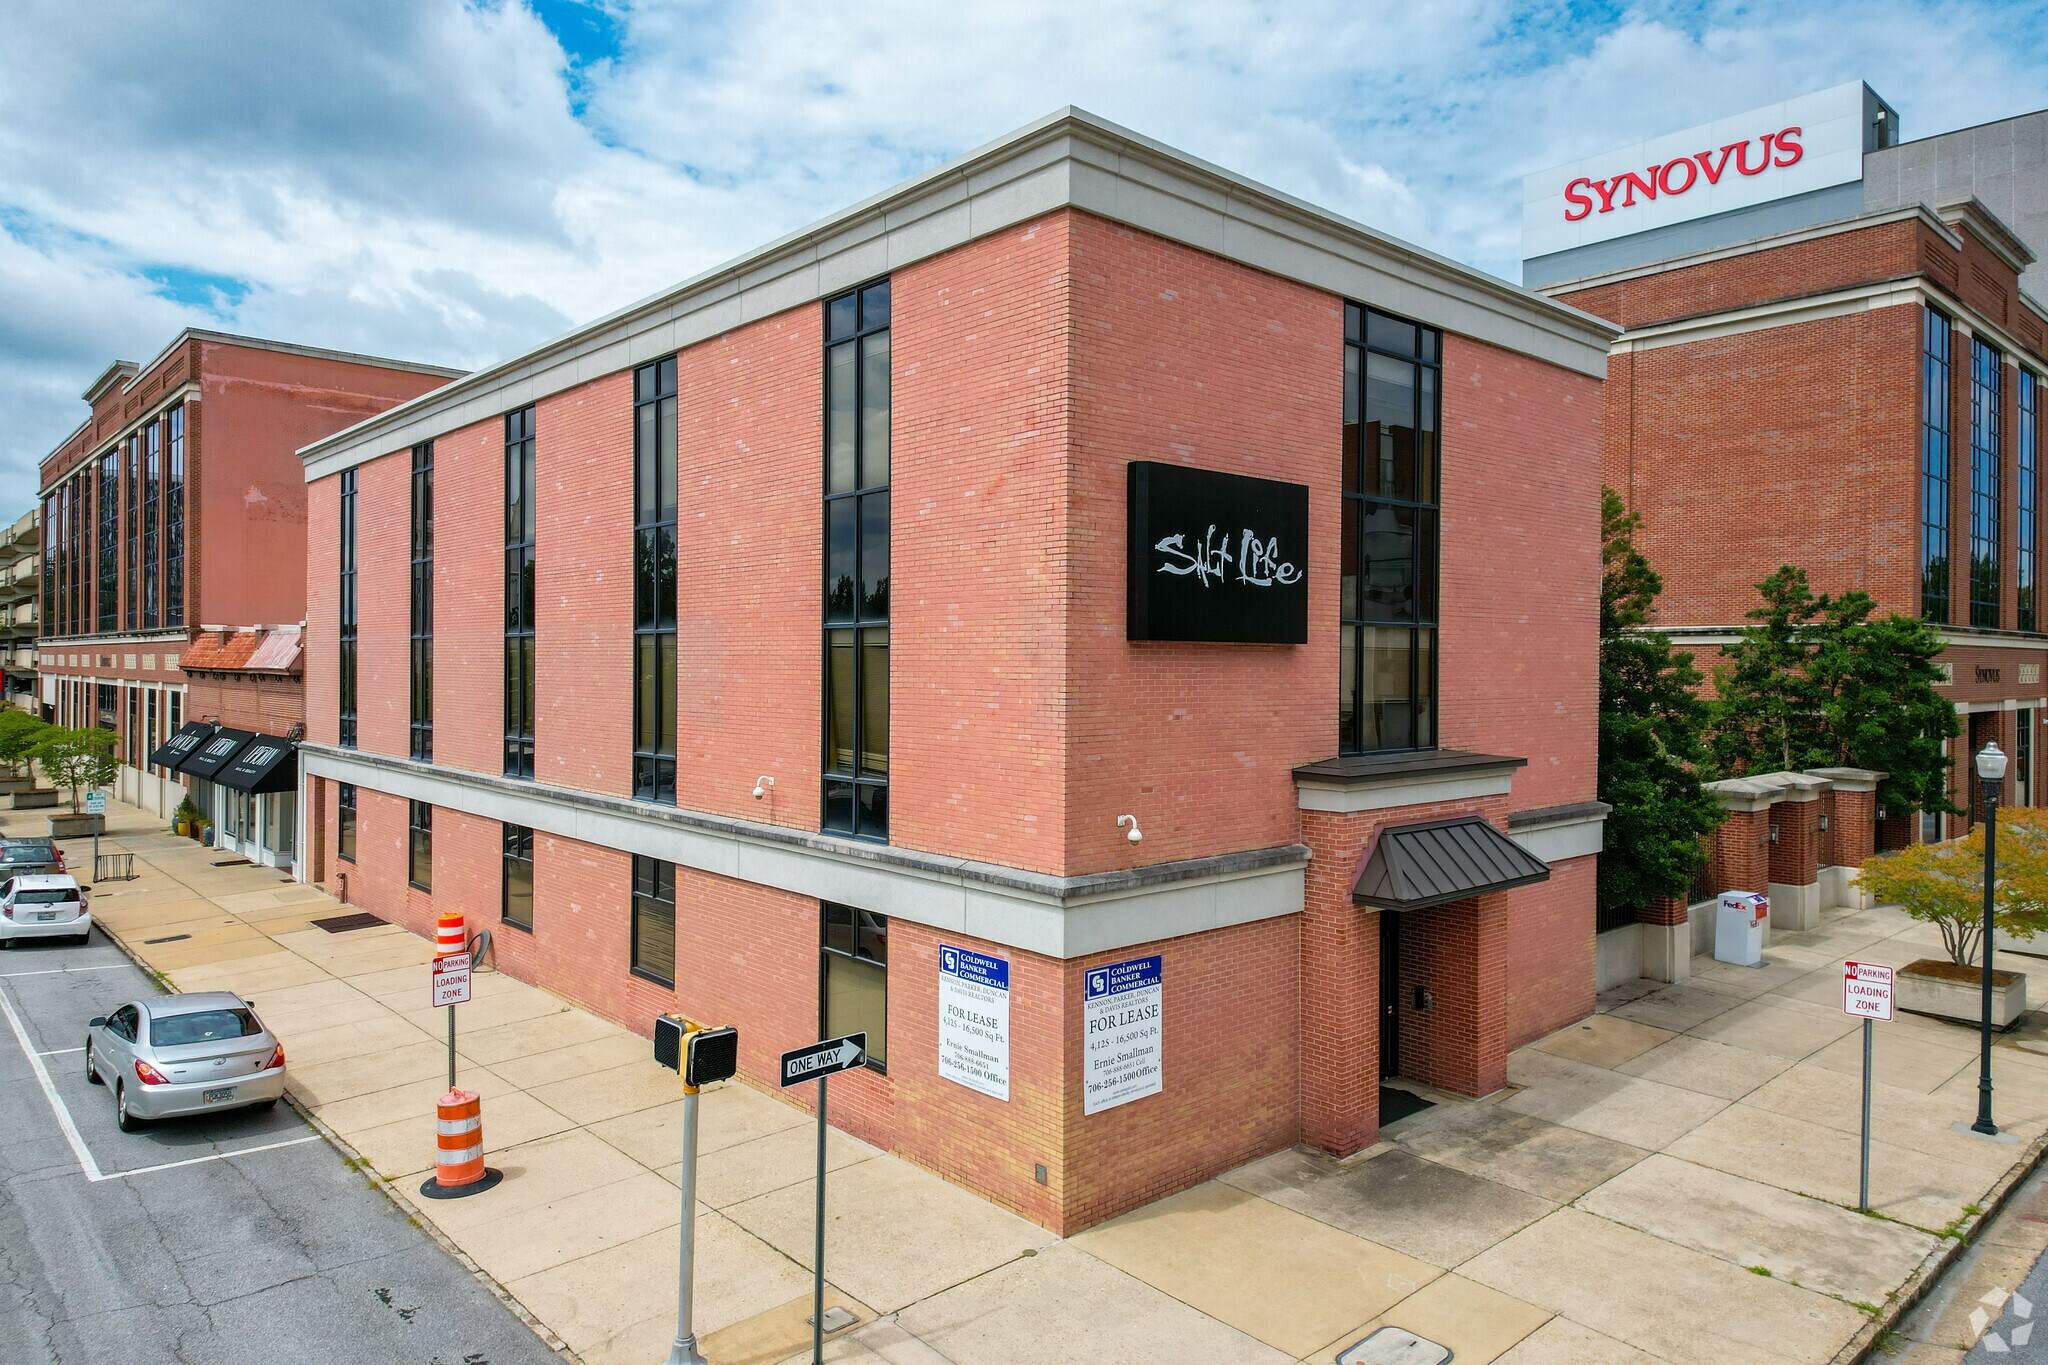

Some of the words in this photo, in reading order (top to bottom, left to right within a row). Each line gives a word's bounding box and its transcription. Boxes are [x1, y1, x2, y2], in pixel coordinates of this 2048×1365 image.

[1564, 126, 1803, 221] SYNOVUS
[1724, 900, 1747, 911] FedEx
[432, 961, 443, 971] NO
[444, 958, 469, 968] PARKING
[960, 961, 987, 975] BANKER
[961, 954, 998, 970] COLDWELL
[1111, 961, 1152, 976] COLDWELL
[960, 970, 1007, 989] COMMERCIAL
[1111, 972, 1141, 985] BANKER
[1845, 964, 1857, 976] NO
[1859, 968, 1890, 980] PARKING
[436, 975, 467, 988] LOADING
[1111, 976, 1160, 993] COMMERCIAL
[442, 988, 462, 999] ZONE
[1137, 986, 1160, 997] DUNCAN
[1848, 985, 1889, 999] LOADING
[1105, 1003, 1121, 1013] DAVIS
[1121, 997, 1149, 1009] REALTORS
[1856, 1000, 1880, 1012] ZONE
[948, 1004, 965, 1020] FOR
[967, 1010, 998, 1029] LEASE
[1089, 1015, 1117, 1035] FOR
[1119, 1004, 1159, 1026] LEASE
[963, 1023, 983, 1036] 16,500
[985, 1031, 994, 1042] Sq
[995, 1033, 1005, 1043] Ft.
[1090, 1039, 1110, 1052] 4,125
[1116, 1031, 1139, 1044] 16,500
[1140, 1029, 1149, 1039] Sq
[1150, 1027, 1159, 1036] Ft.
[790, 1056, 813, 1074] ONE
[817, 1049, 840, 1066] WAY
[964, 1045, 999, 1063] Smallman
[1094, 1057, 1115, 1071] Ernie
[1117, 1046, 1154, 1063] Smallman
[983, 1071, 1007, 1085] Office
